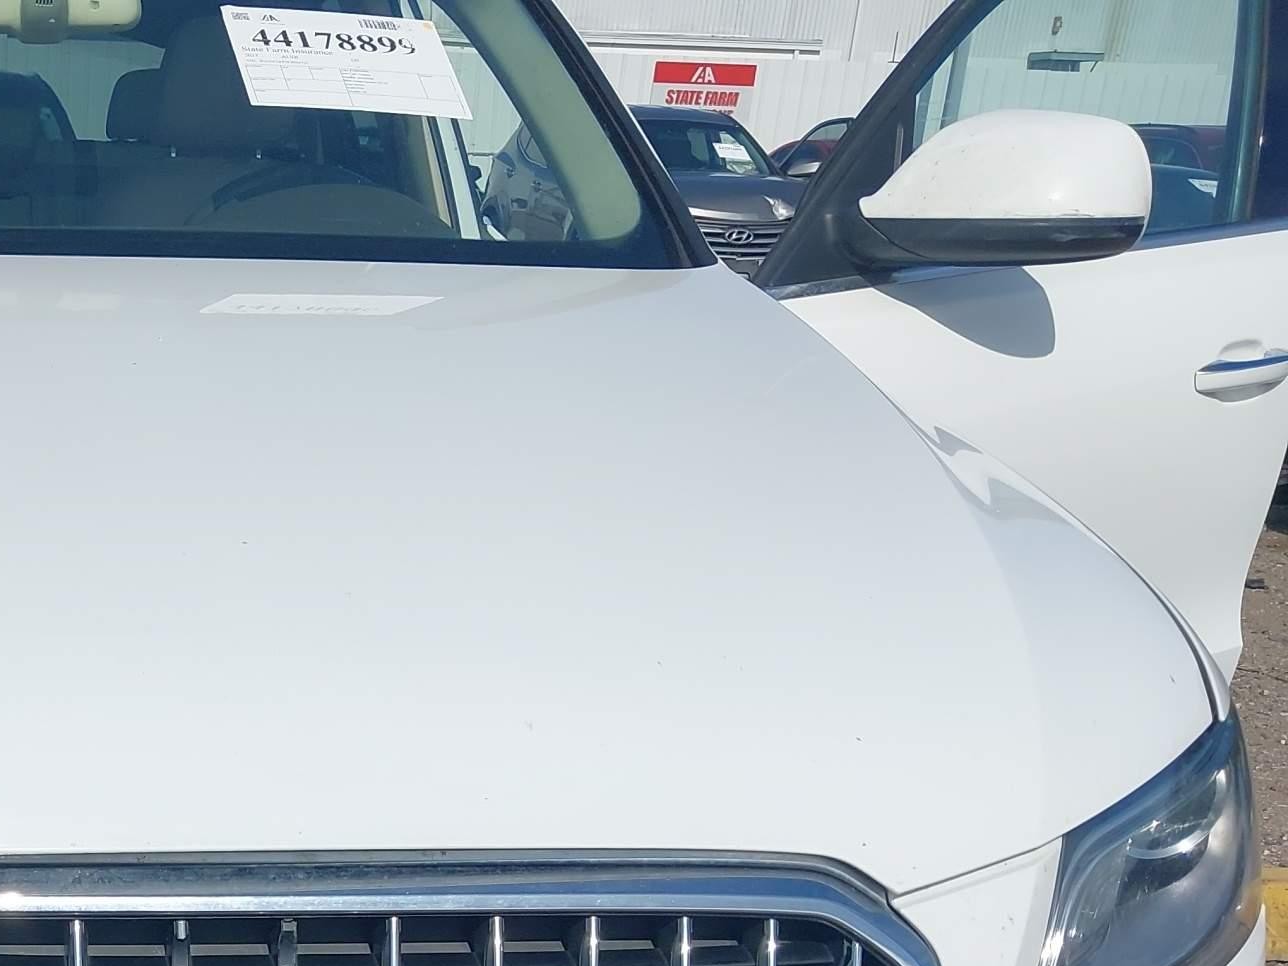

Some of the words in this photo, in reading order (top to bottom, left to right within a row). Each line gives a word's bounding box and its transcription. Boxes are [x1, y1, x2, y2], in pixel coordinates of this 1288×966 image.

[252, 28, 416, 55] 44178899
[665, 89, 702, 106] STATE
[703, 90, 740, 107] FARM
